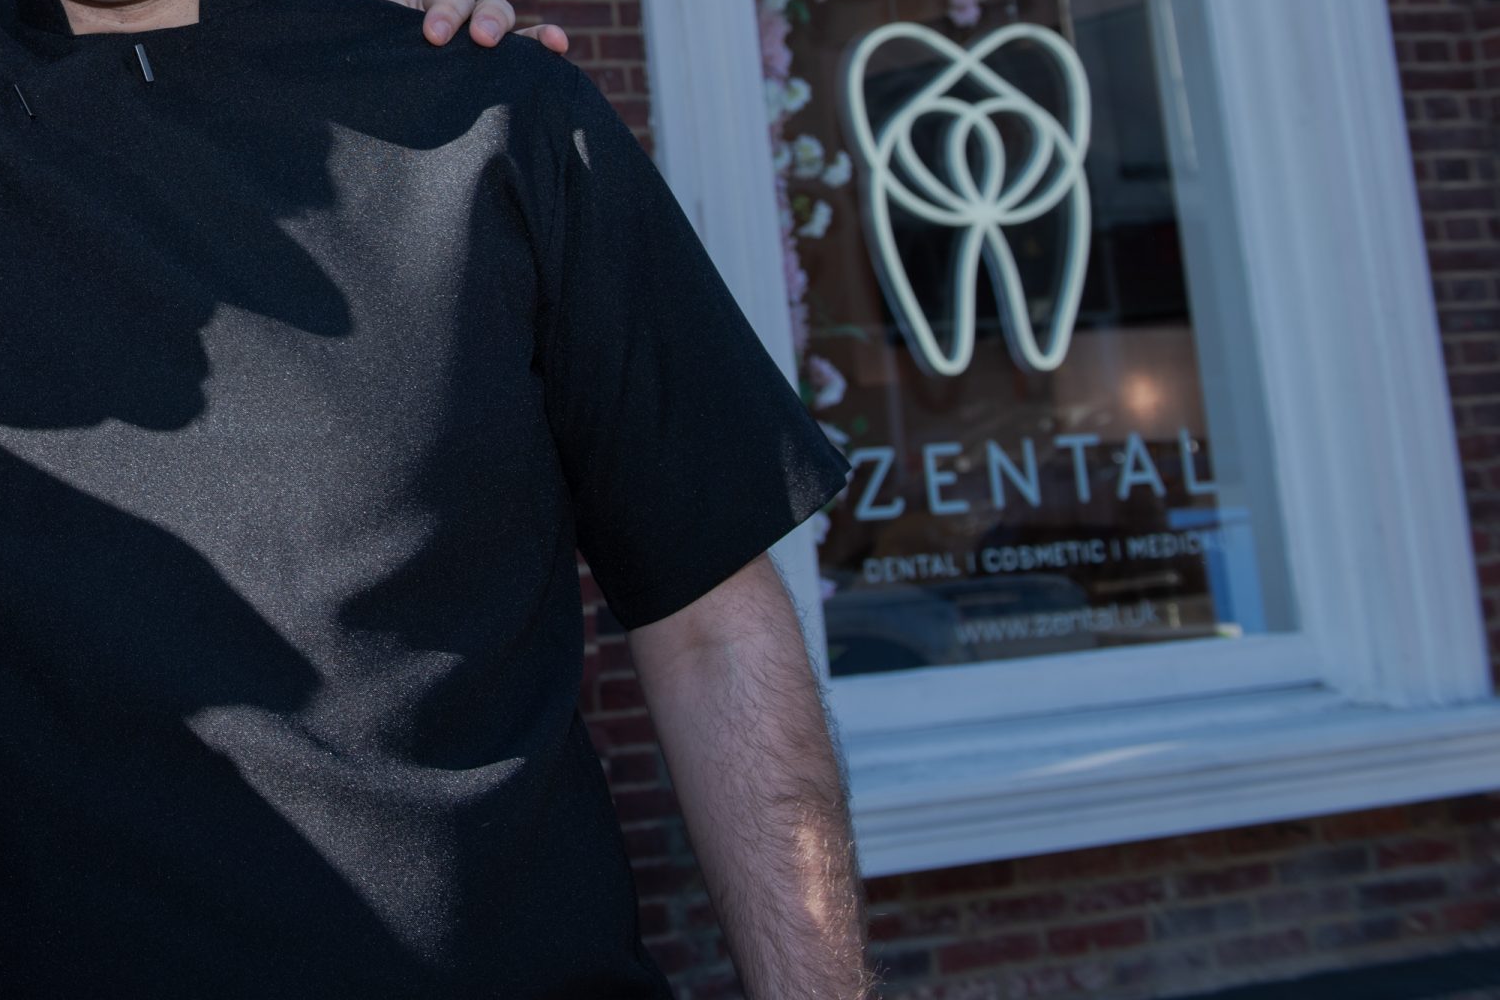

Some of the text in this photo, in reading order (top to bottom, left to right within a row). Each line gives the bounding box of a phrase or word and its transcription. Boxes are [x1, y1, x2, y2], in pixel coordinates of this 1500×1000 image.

[849, 427, 1219, 521] ZENTAL
[863, 552, 961, 584] DENTAL
[982, 540, 1107, 573] COSMETIC
